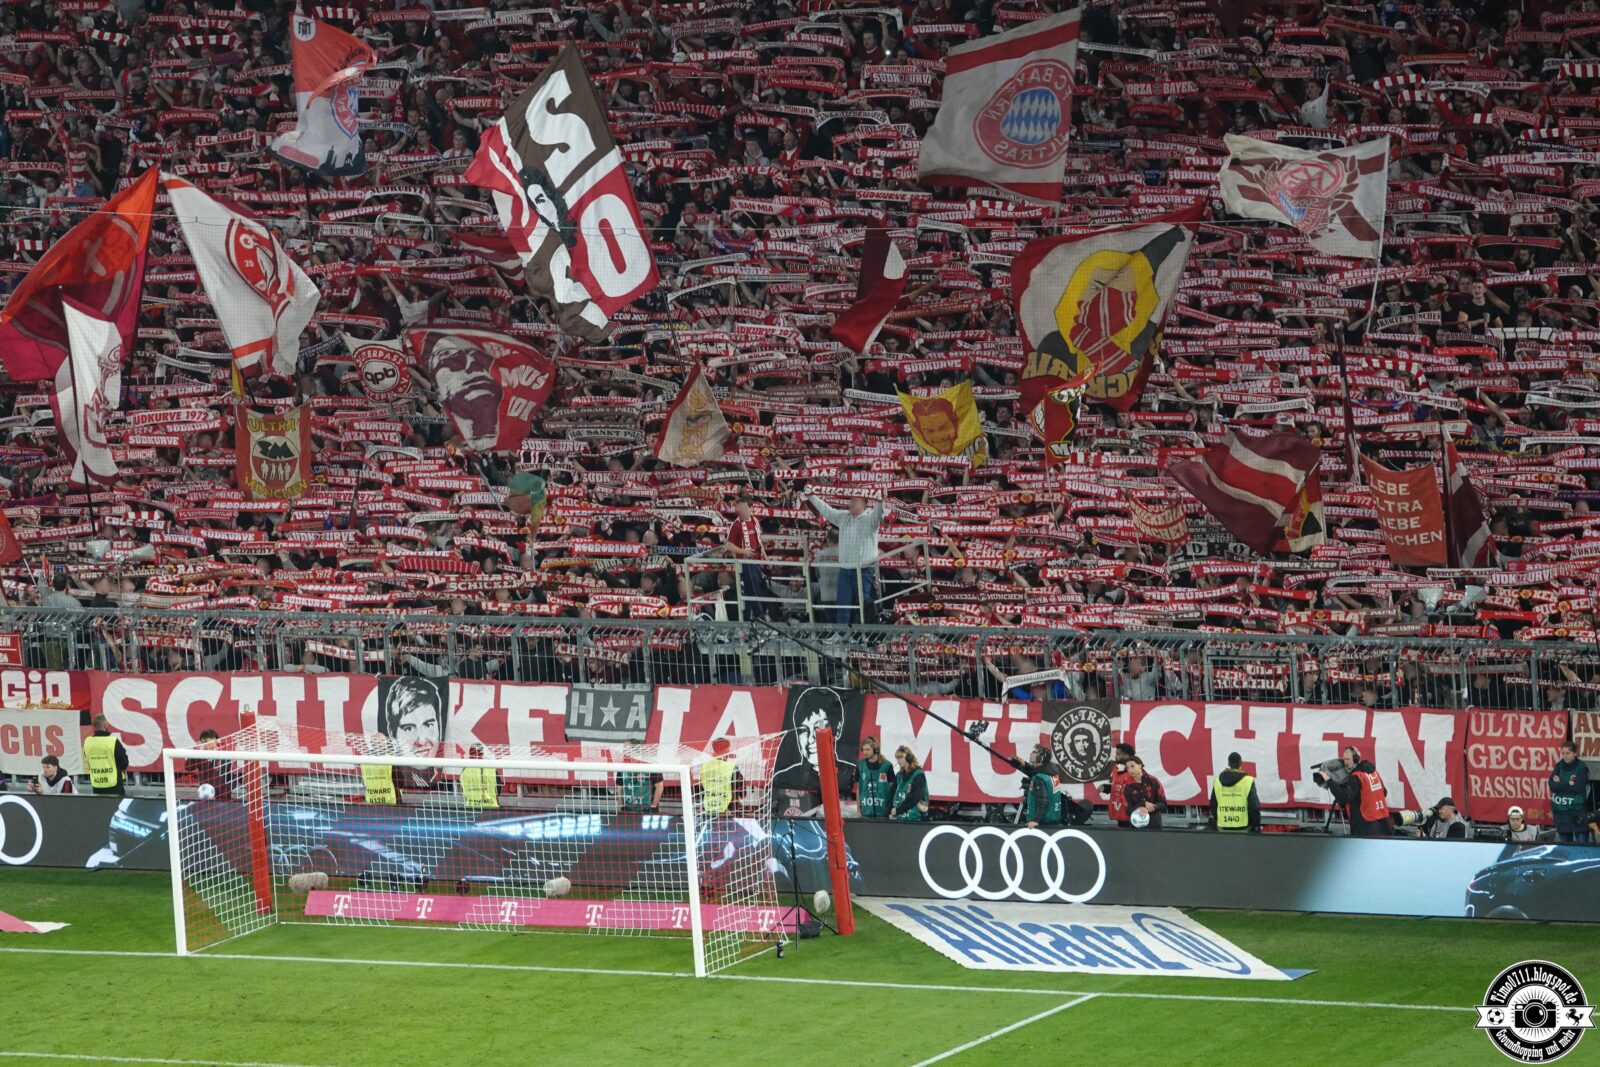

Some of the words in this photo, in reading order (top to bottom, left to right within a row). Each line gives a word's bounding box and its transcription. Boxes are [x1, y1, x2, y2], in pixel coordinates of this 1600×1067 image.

[247, 418, 299, 432] ULTRA
[1370, 474, 1410, 496] LEBE
[1383, 530, 1443, 546] NCHEN
[102, 676, 766, 783] SCHIKEIA
[1061, 710, 1106, 729] ULTRA
[1470, 712, 1567, 739] ULTRAS
[876, 697, 1454, 808] MÜCHEN
[1468, 743, 1563, 771] GEGEN
[886, 903, 1190, 970] Allianz
